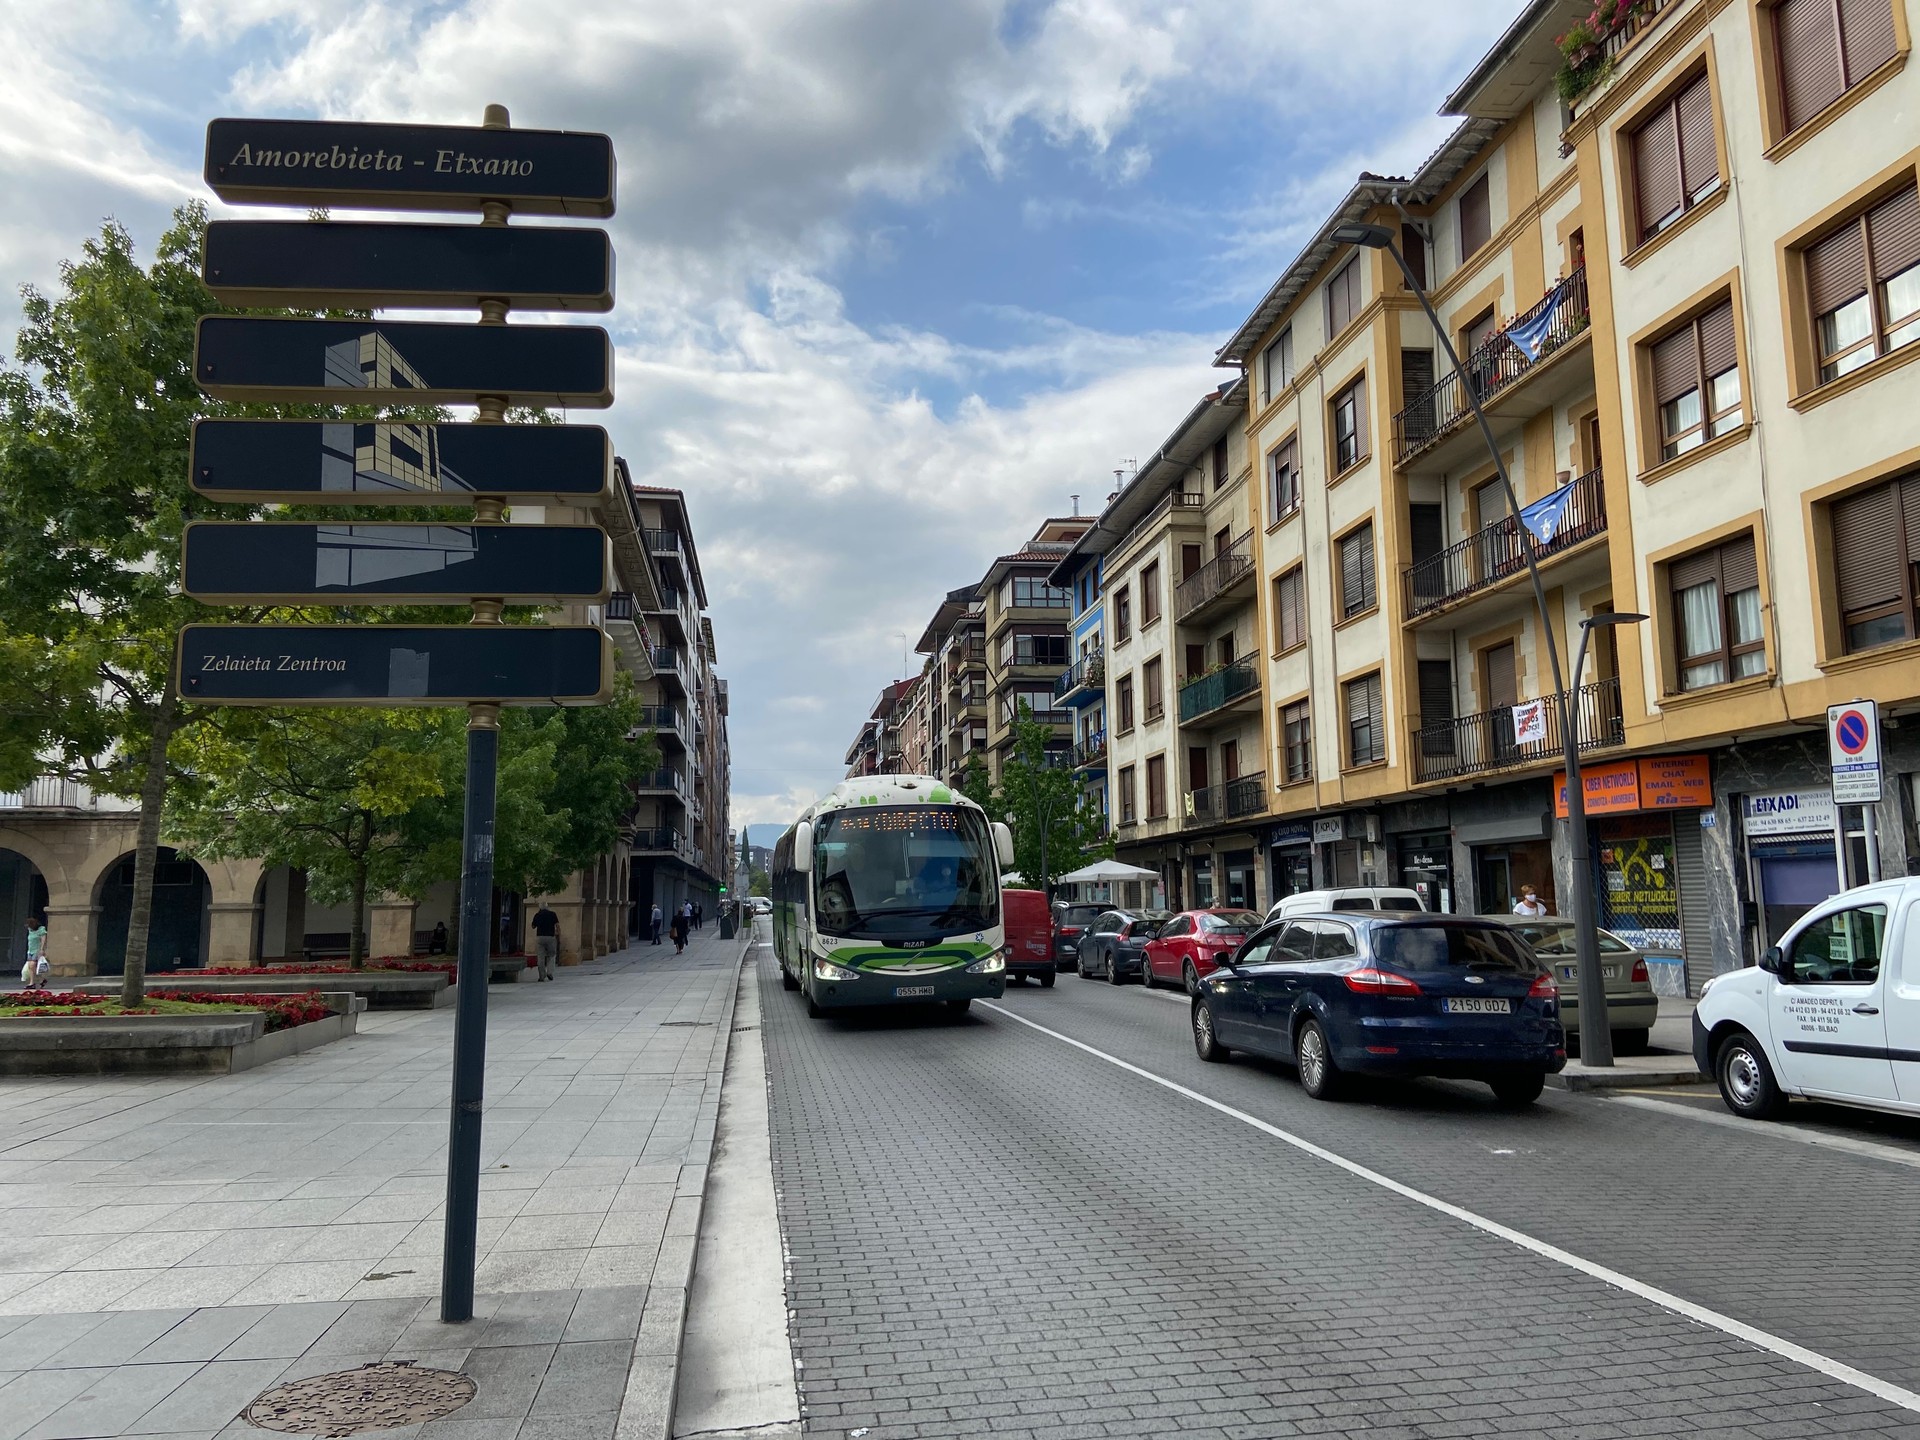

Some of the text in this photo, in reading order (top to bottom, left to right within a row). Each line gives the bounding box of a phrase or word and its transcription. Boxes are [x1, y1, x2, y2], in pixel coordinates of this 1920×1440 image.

[229, 143, 403, 171] Amorebieta
[434, 150, 533, 176] Etxano
[201, 655, 347, 671] Zelaieta Zentroa
[1651, 759, 1694, 769] INTERNET
[1661, 770, 1686, 778] CHAT
[1585, 772, 1635, 792] CIBER NETWORLD
[1645, 781, 1675, 789] EMAIL
[1683, 779, 1704, 787] WEB
[1655, 792, 1678, 805] Ria
[1755, 794, 1799, 813] ETXADI
[1633, 890, 1676, 902] NETWORLD
[1451, 999, 1508, 1012] 2150 GDZ
[1818, 1025, 1838, 1033] BILBAO
